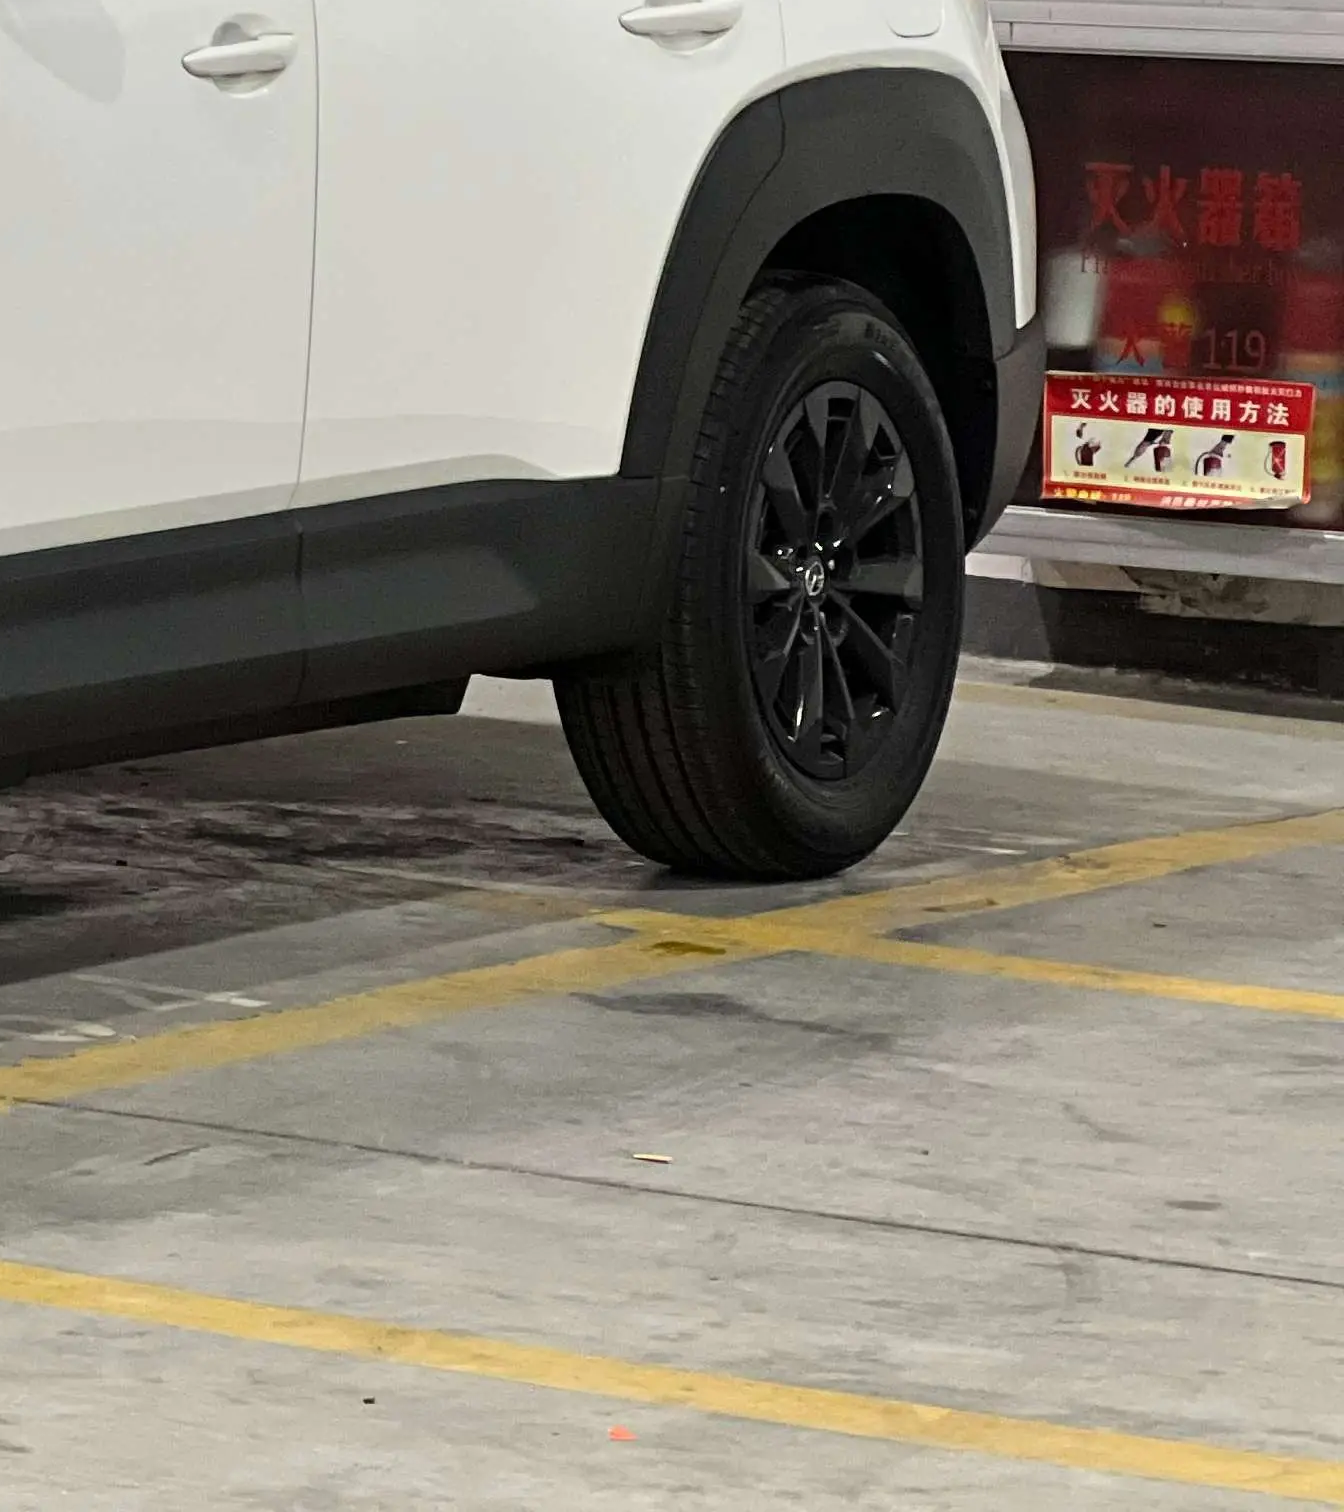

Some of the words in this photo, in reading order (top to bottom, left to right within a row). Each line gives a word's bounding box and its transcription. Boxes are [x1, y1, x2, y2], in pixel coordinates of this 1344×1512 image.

[1070, 388, 1290, 427] 灭火器的使用方法
